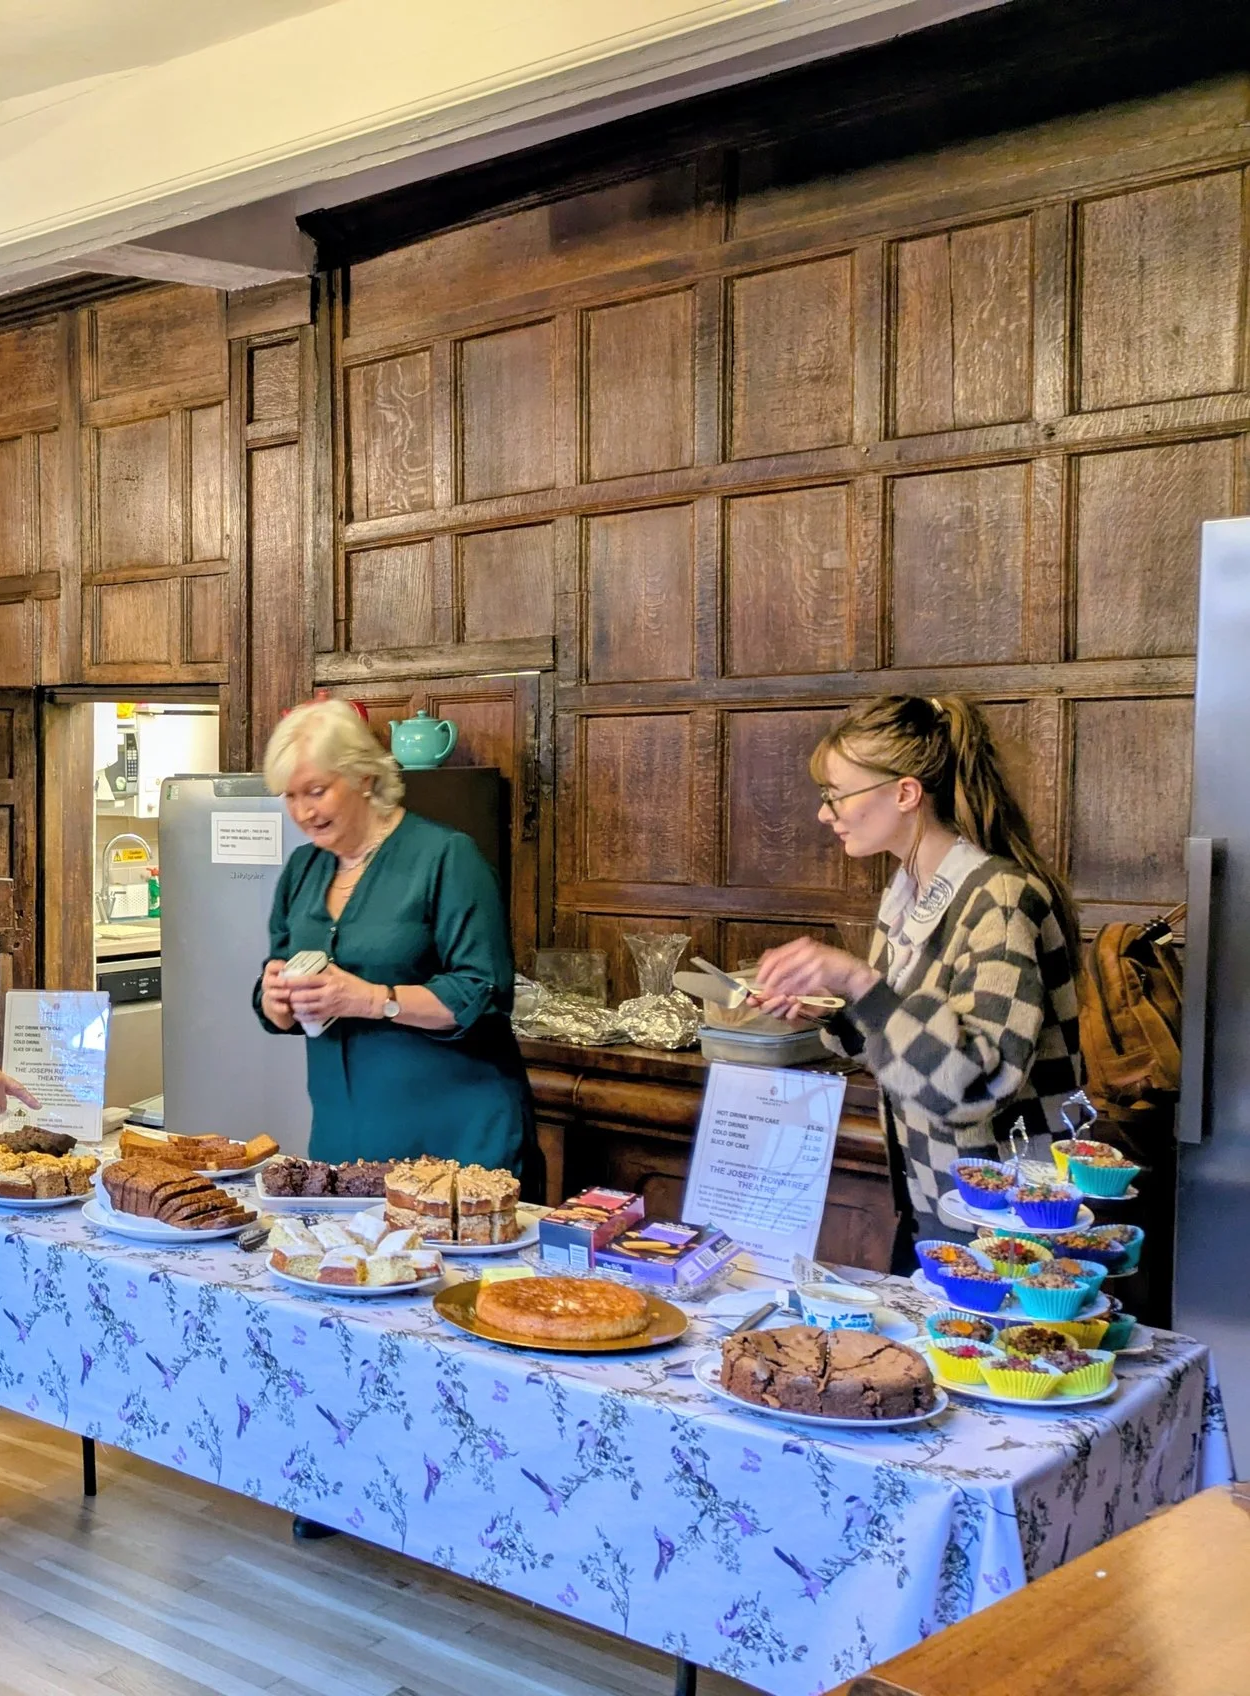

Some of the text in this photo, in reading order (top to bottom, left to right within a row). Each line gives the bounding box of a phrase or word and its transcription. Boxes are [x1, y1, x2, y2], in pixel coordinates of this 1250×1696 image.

[716, 1109, 780, 1125] HOT DRINK WITH CAKE
[727, 1121, 749, 1130] DRINKS
[712, 1128, 746, 1139] COLD DRINK
[710, 1138, 725, 1146] SLICE
[734, 1142, 750, 1151] CAKE
[709, 1165, 725, 1175] THE
[726, 1169, 760, 1181] JOSEPH
[761, 1175, 810, 1191] ROWNTREE
[737, 1180, 776, 1193] THEATRE
